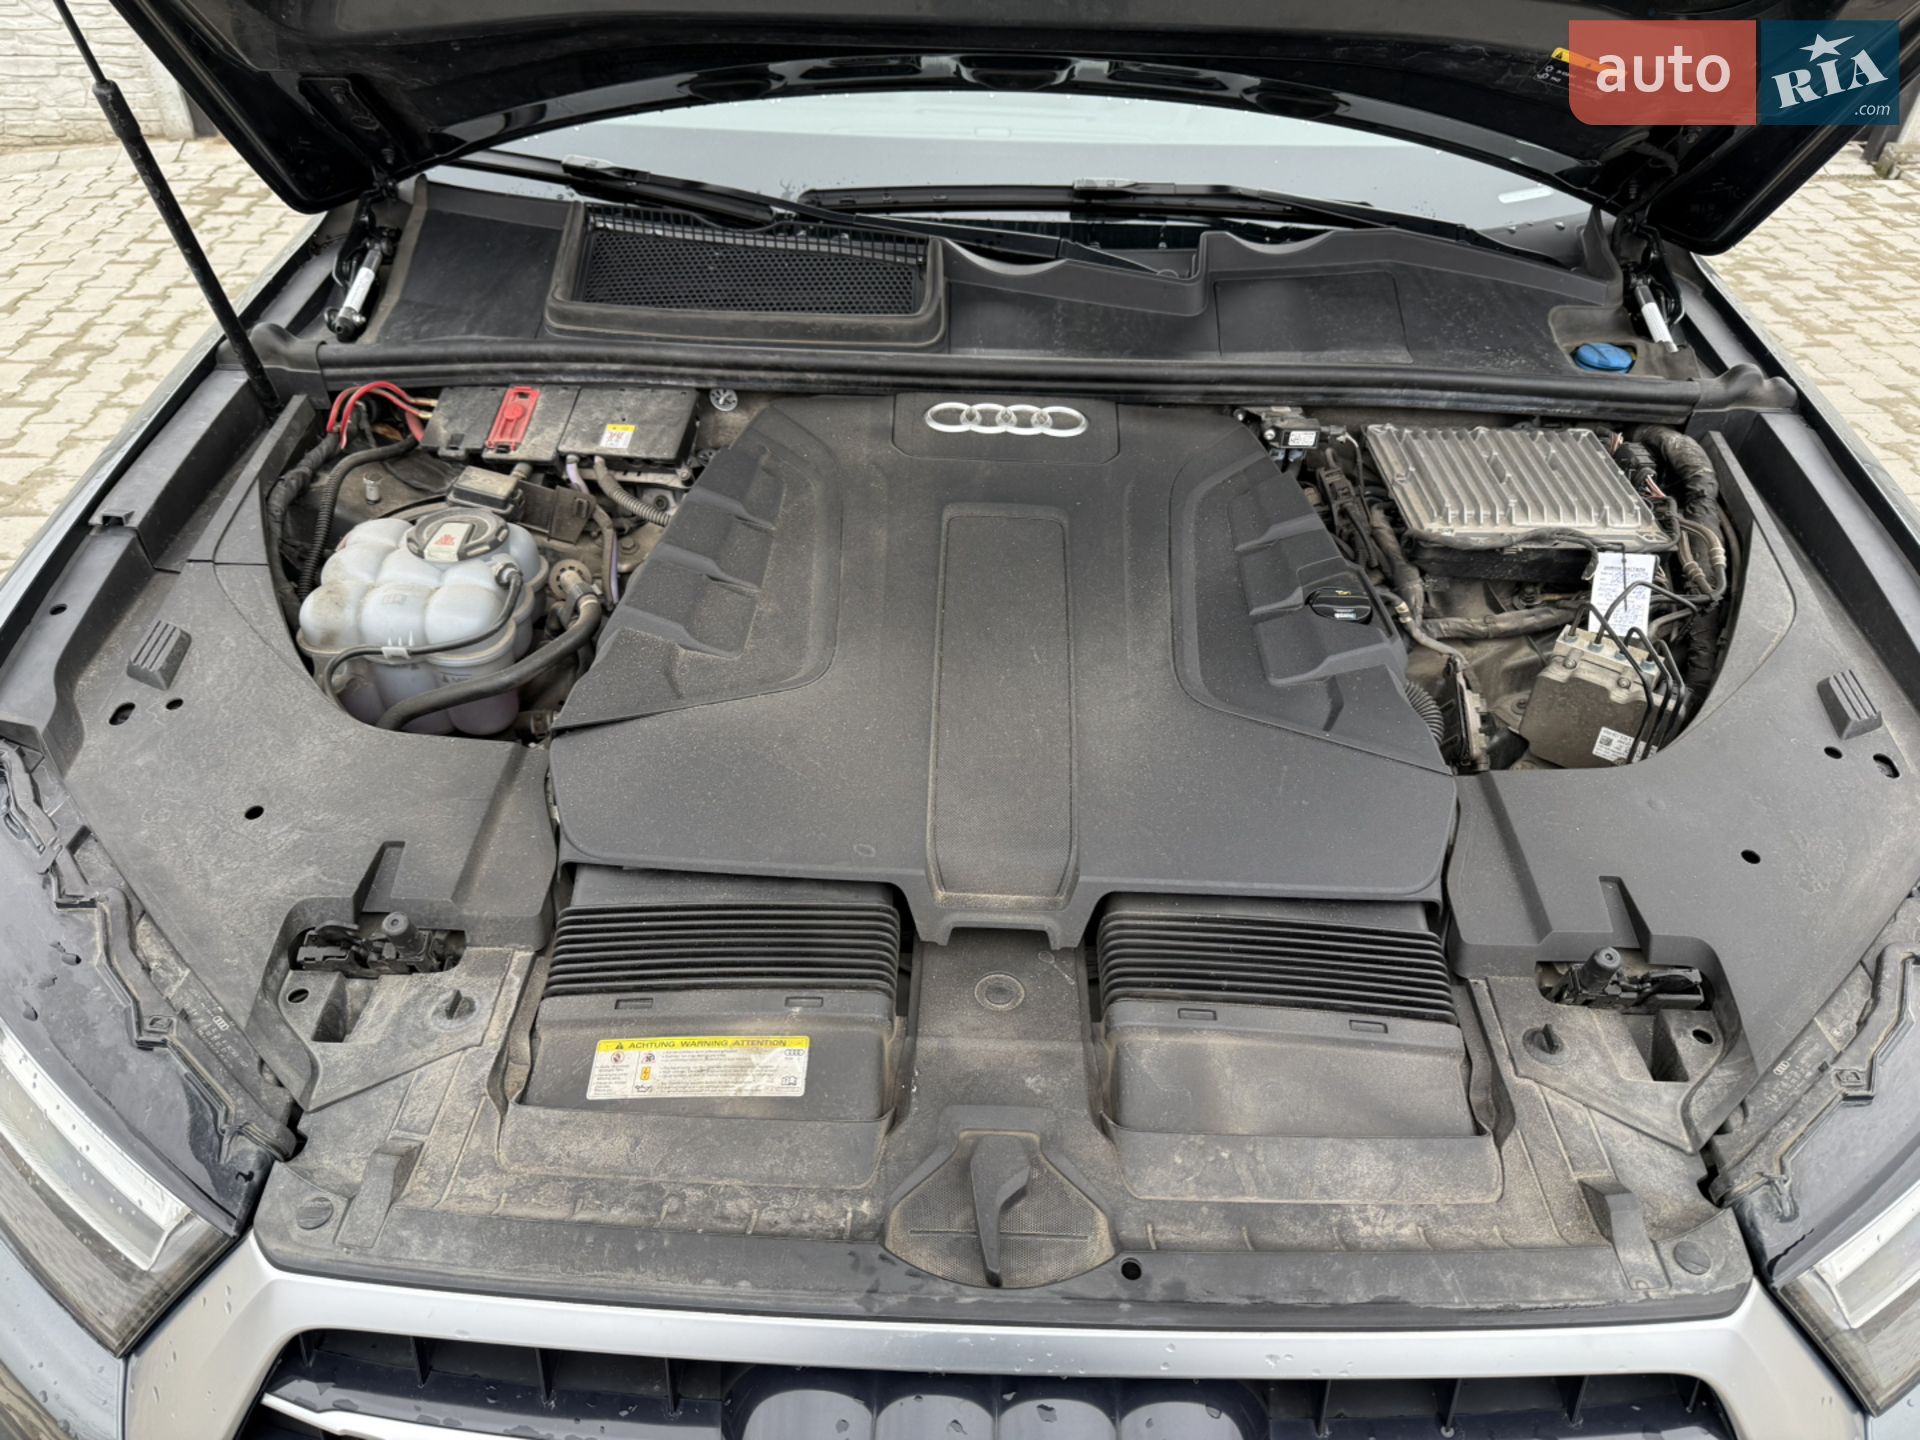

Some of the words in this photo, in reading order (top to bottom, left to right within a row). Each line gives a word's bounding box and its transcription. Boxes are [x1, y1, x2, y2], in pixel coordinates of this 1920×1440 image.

[628, 1041, 676, 1049] ACHTUNG
[680, 1039, 729, 1048] WARNING
[732, 1039, 788, 1047] ATTENTION
